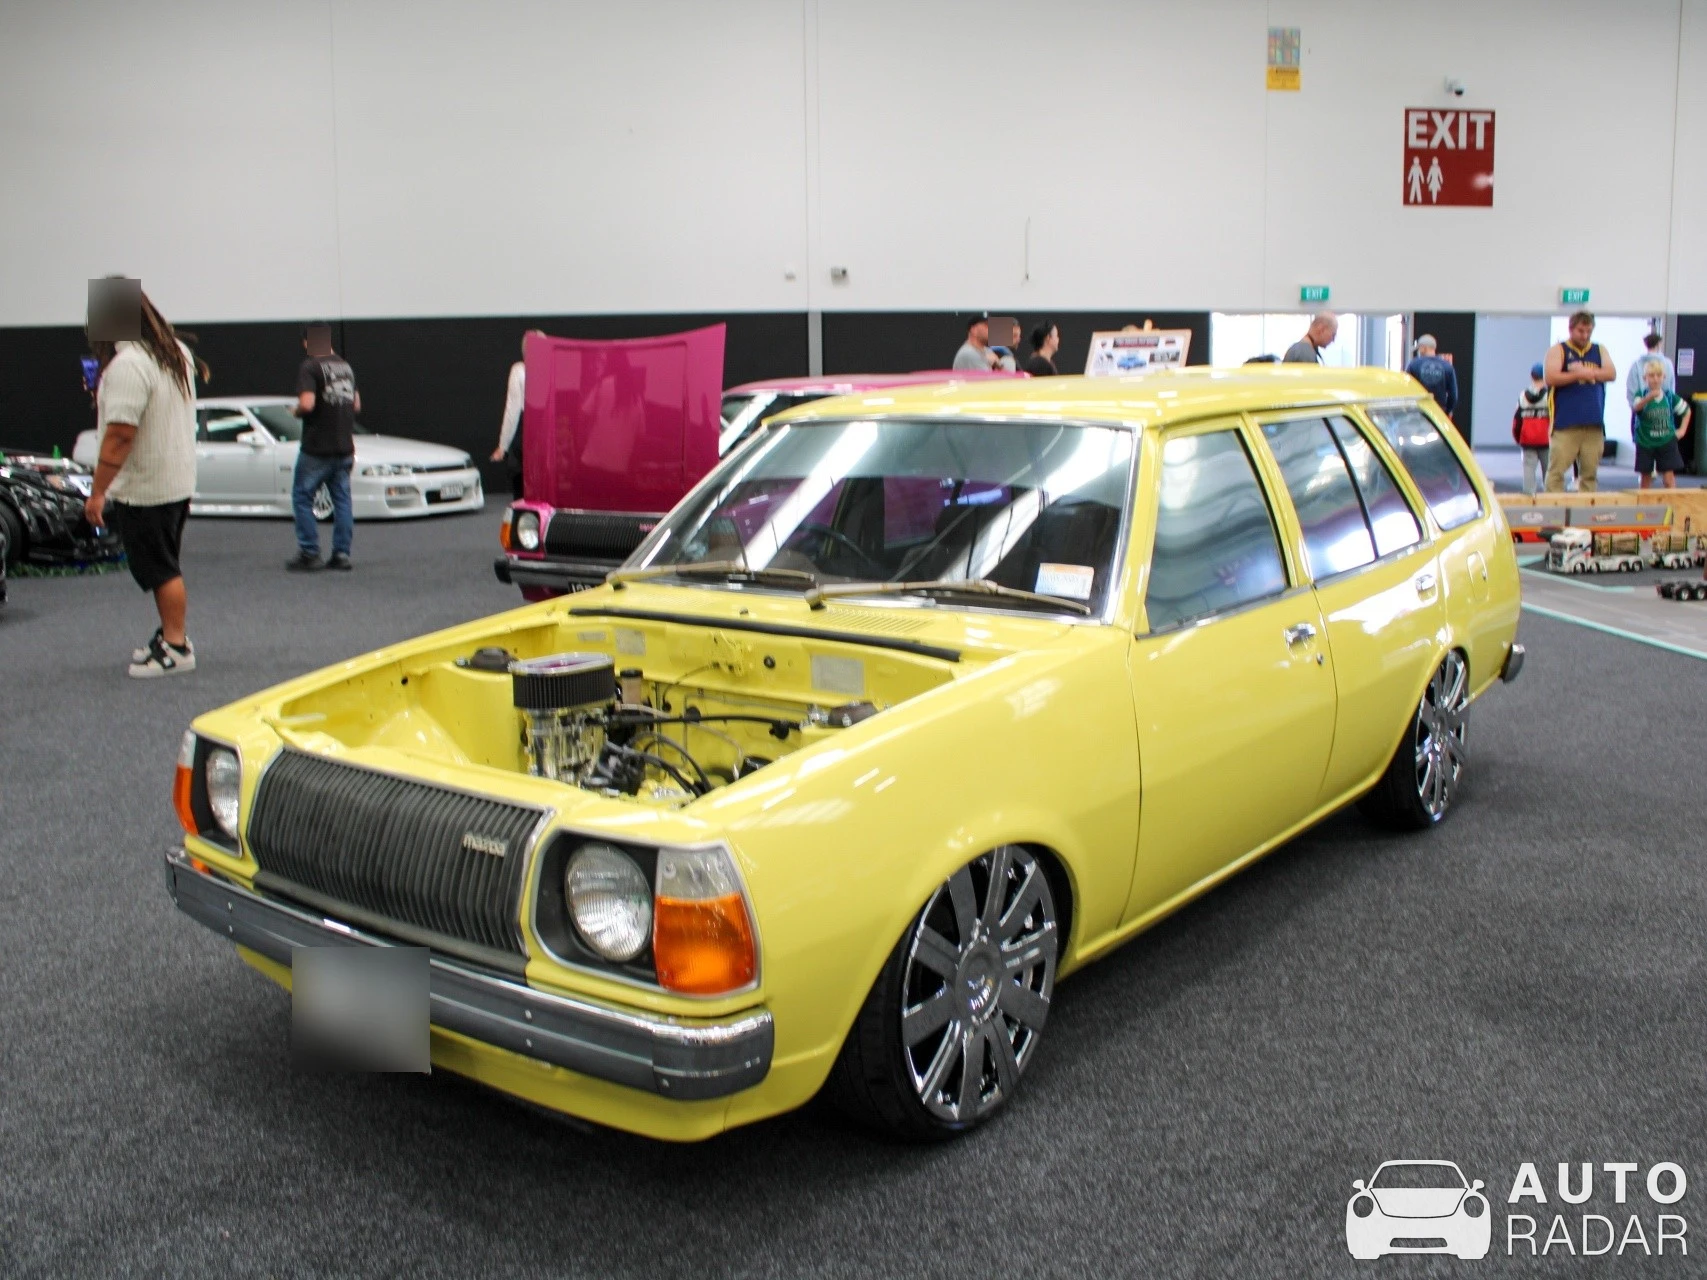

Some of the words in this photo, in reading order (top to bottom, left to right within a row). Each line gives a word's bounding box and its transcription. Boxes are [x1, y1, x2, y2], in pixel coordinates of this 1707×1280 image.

[1408, 111, 1491, 150] EXIT
[1306, 287, 1323, 300] EXIT
[1567, 290, 1584, 302] EXIT
